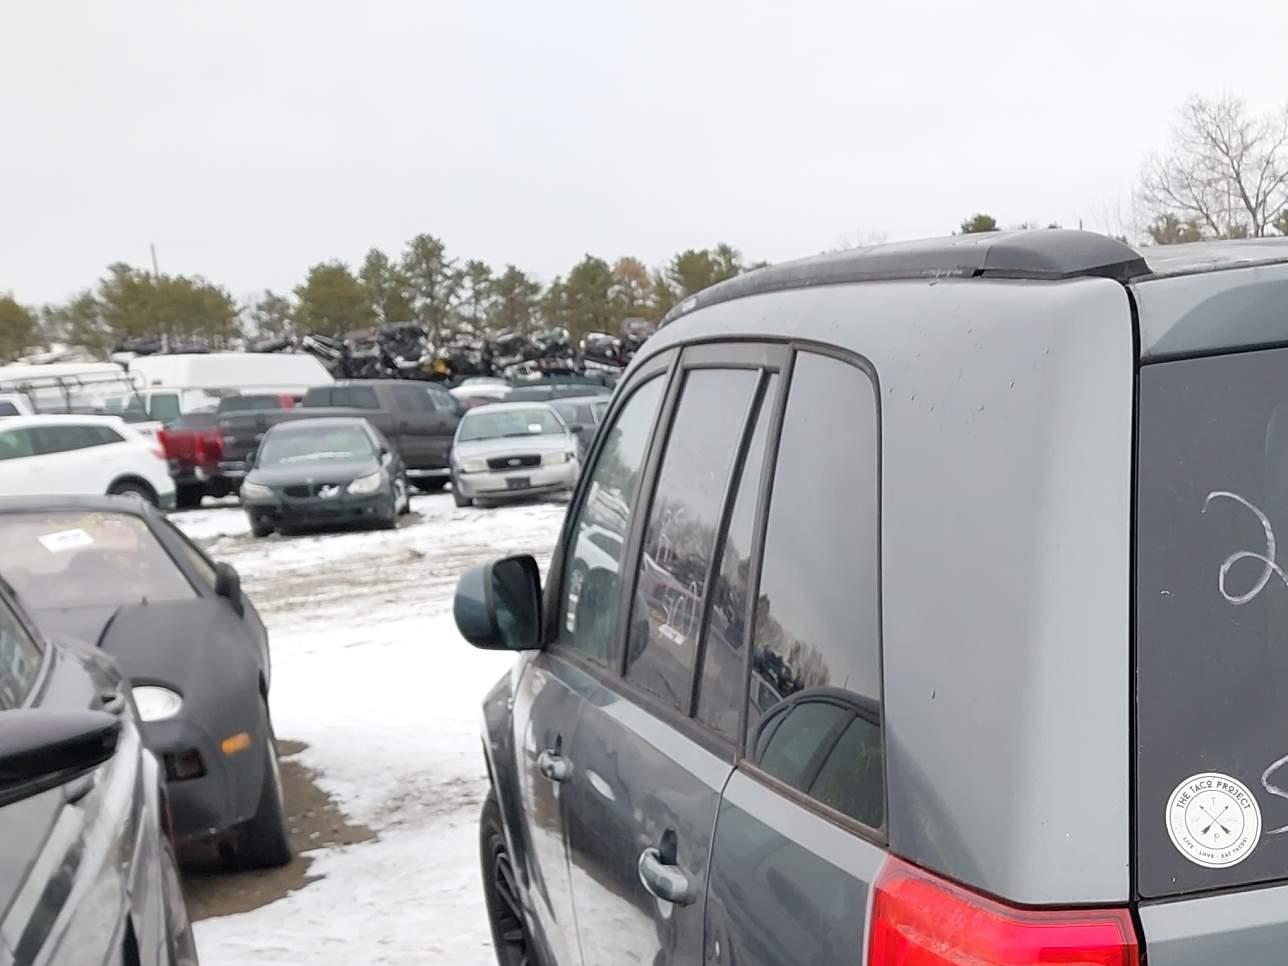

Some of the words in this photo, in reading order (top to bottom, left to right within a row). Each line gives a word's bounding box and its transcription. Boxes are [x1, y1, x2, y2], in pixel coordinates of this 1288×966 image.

[1176, 791, 1192, 809] THE
[1189, 780, 1213, 794] TACO
[1216, 781, 1251, 809] PROJECT
[1182, 836, 1195, 849] LIVE
[1199, 850, 1215, 859] LOVE
[1220, 851, 1232, 859] EAT
